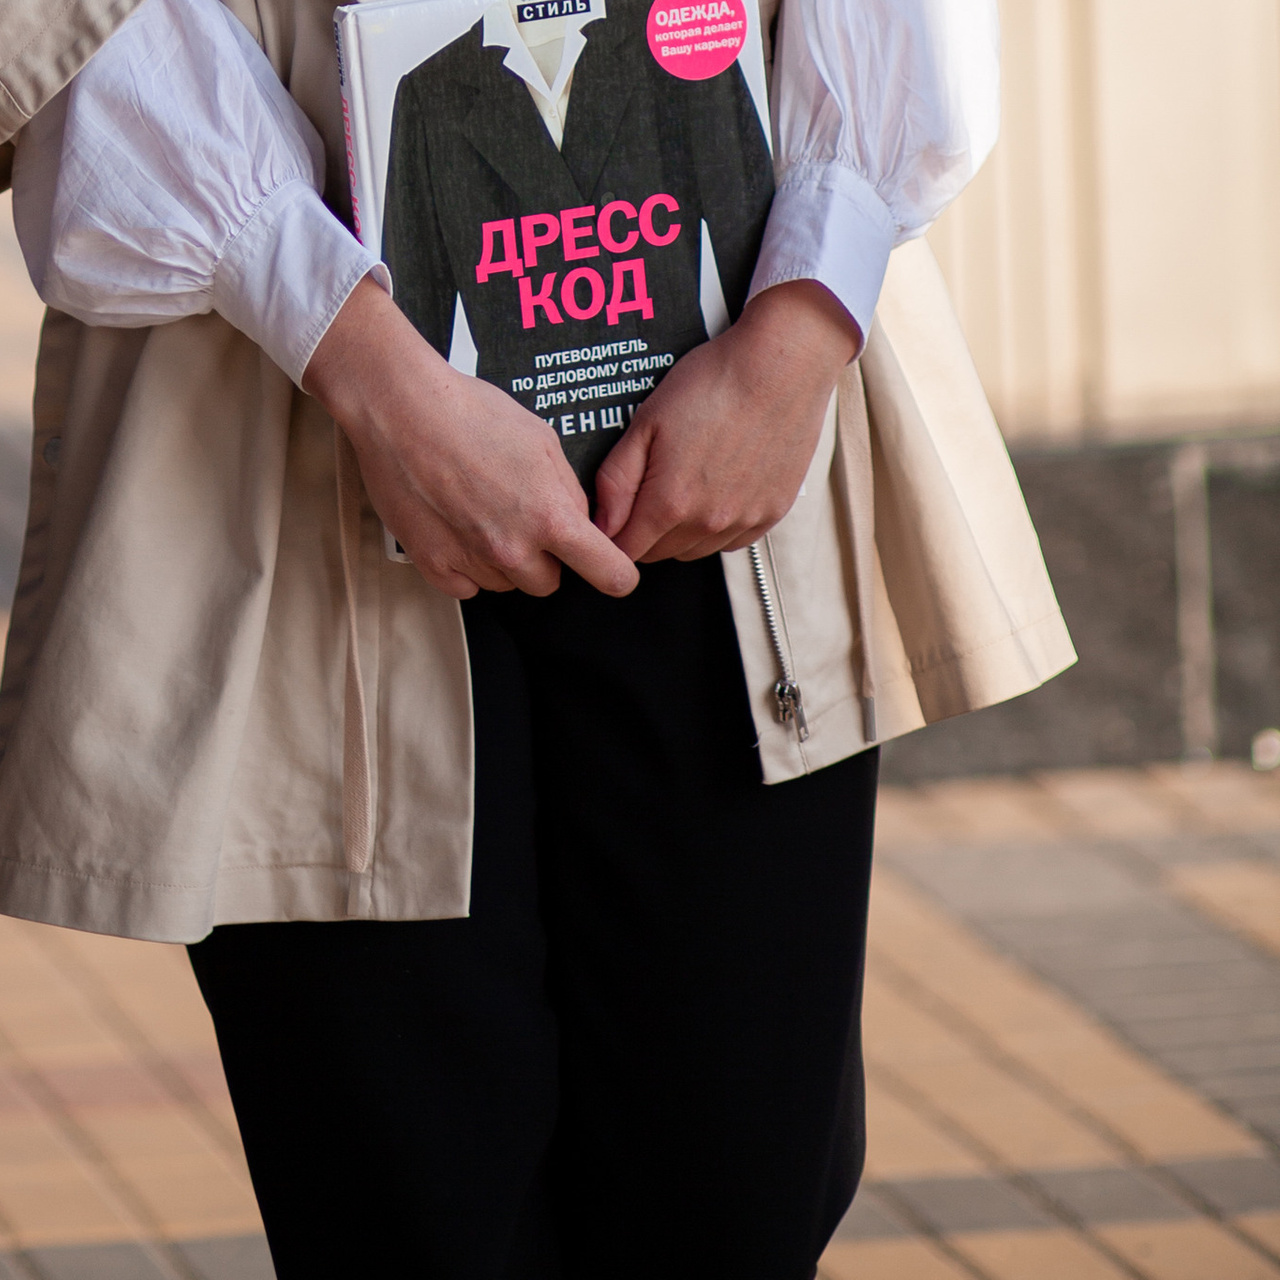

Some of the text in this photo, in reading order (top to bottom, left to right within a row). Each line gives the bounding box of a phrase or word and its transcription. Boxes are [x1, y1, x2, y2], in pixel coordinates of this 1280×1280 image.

[655, 0, 735, 27] ОДЕЖДА,
[655, 20, 744, 42] которая делает
[661, 36, 741, 57] Вашу карьеру
[340, 95, 364, 247] ДРЕСС-КО
[475, 193, 681, 284] ДРЕСС
[518, 258, 654, 329] КОД
[534, 339, 648, 369] ПУТЕВОДИТЕЛЬ
[512, 353, 674, 392] ПО ДЕЛОВОМУ СТИЛЮ
[535, 376, 655, 411] ДЛЯ УСПЕШНЫХ
